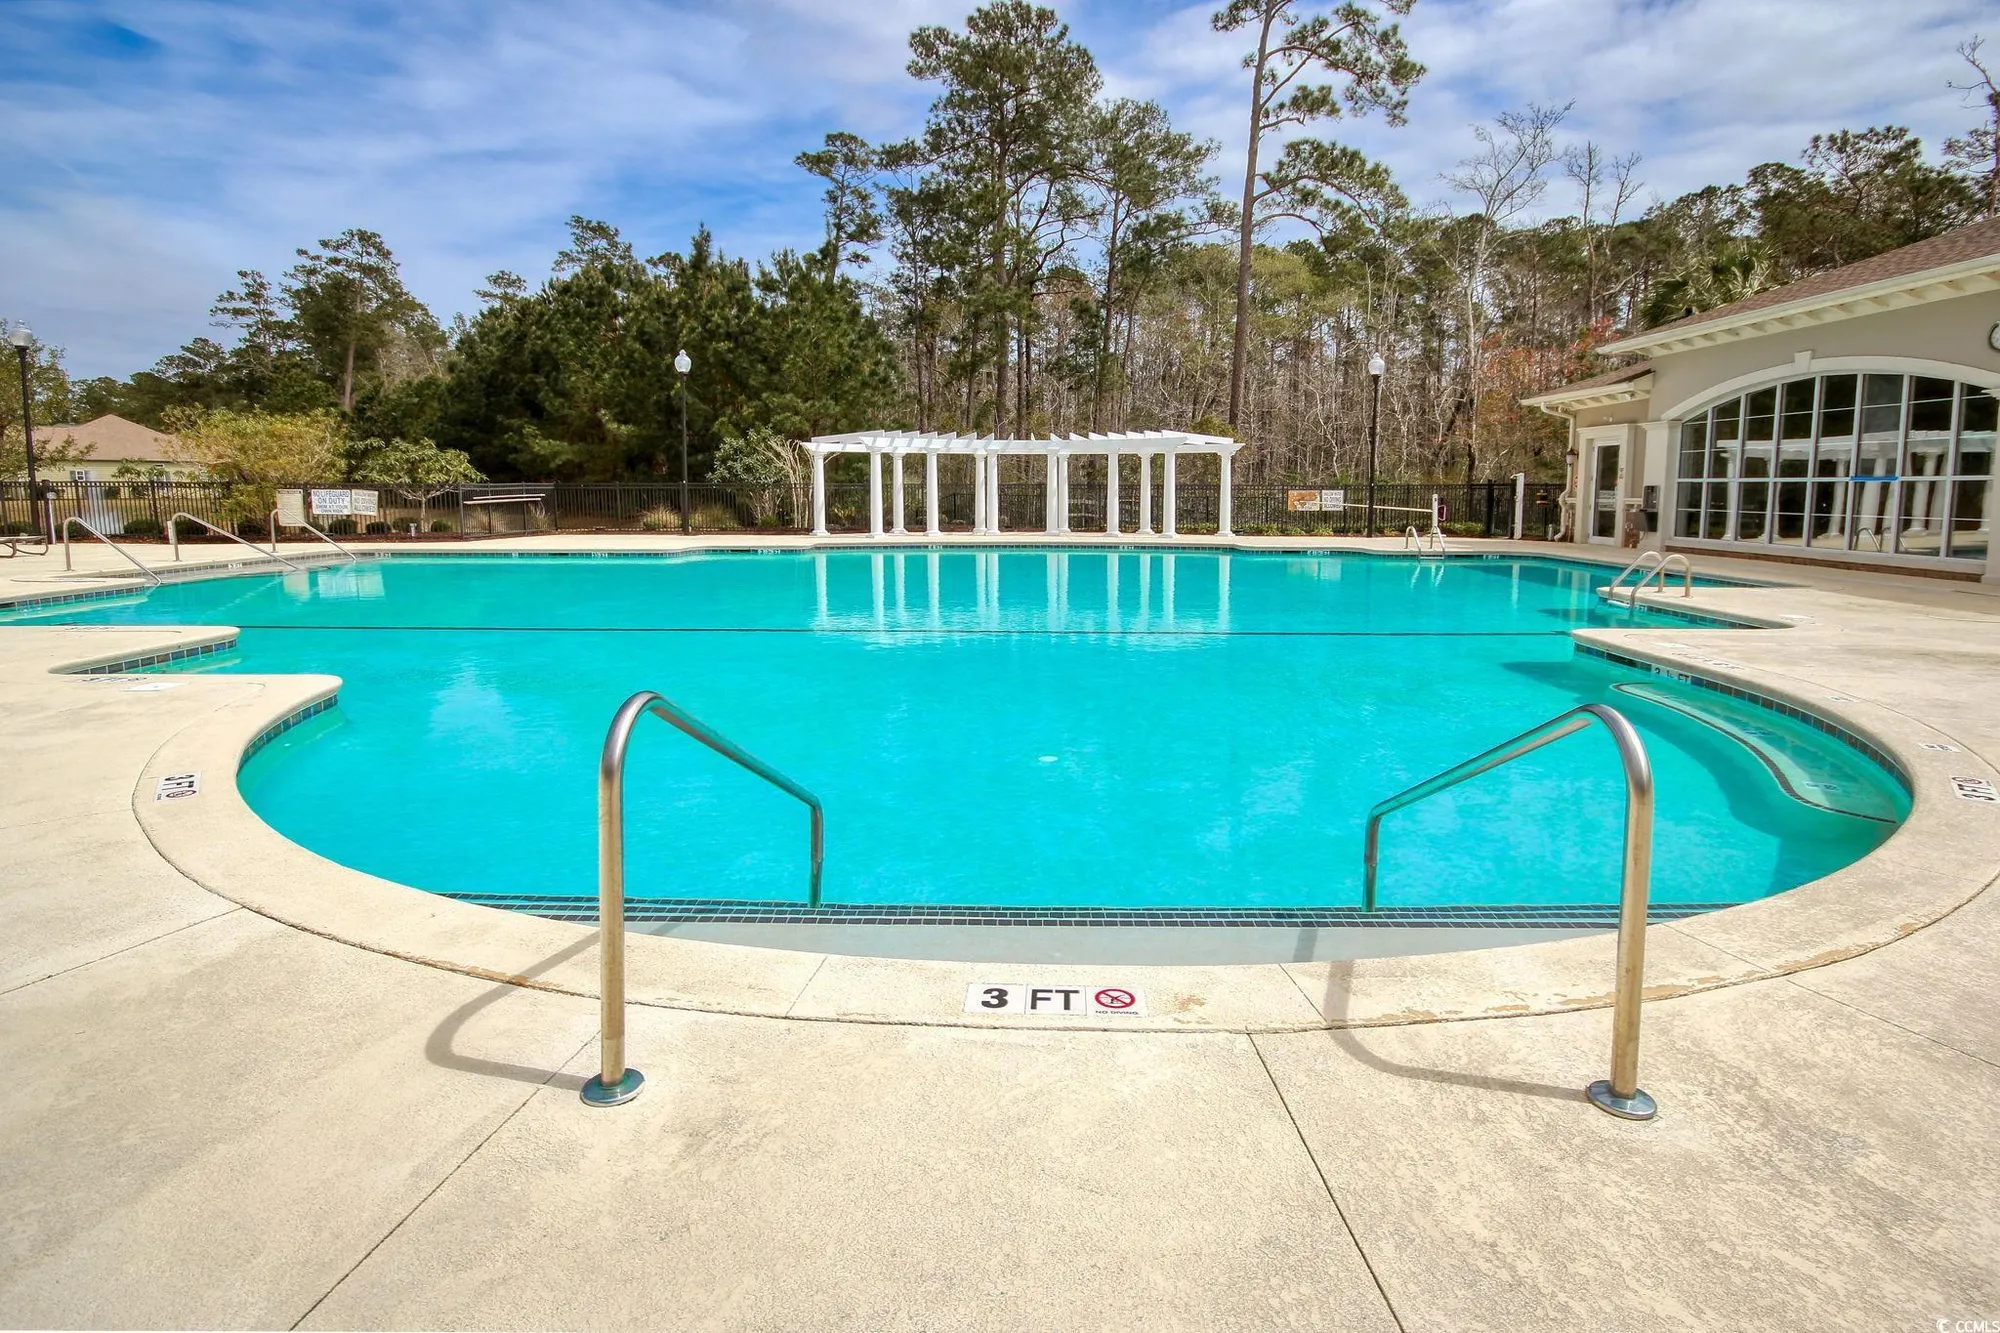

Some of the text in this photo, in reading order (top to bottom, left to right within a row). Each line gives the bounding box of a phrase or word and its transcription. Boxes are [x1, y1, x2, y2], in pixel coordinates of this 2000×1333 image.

[320, 490, 350, 498] LIFEGUARD
[981, 988, 1080, 1011] 3 FT
